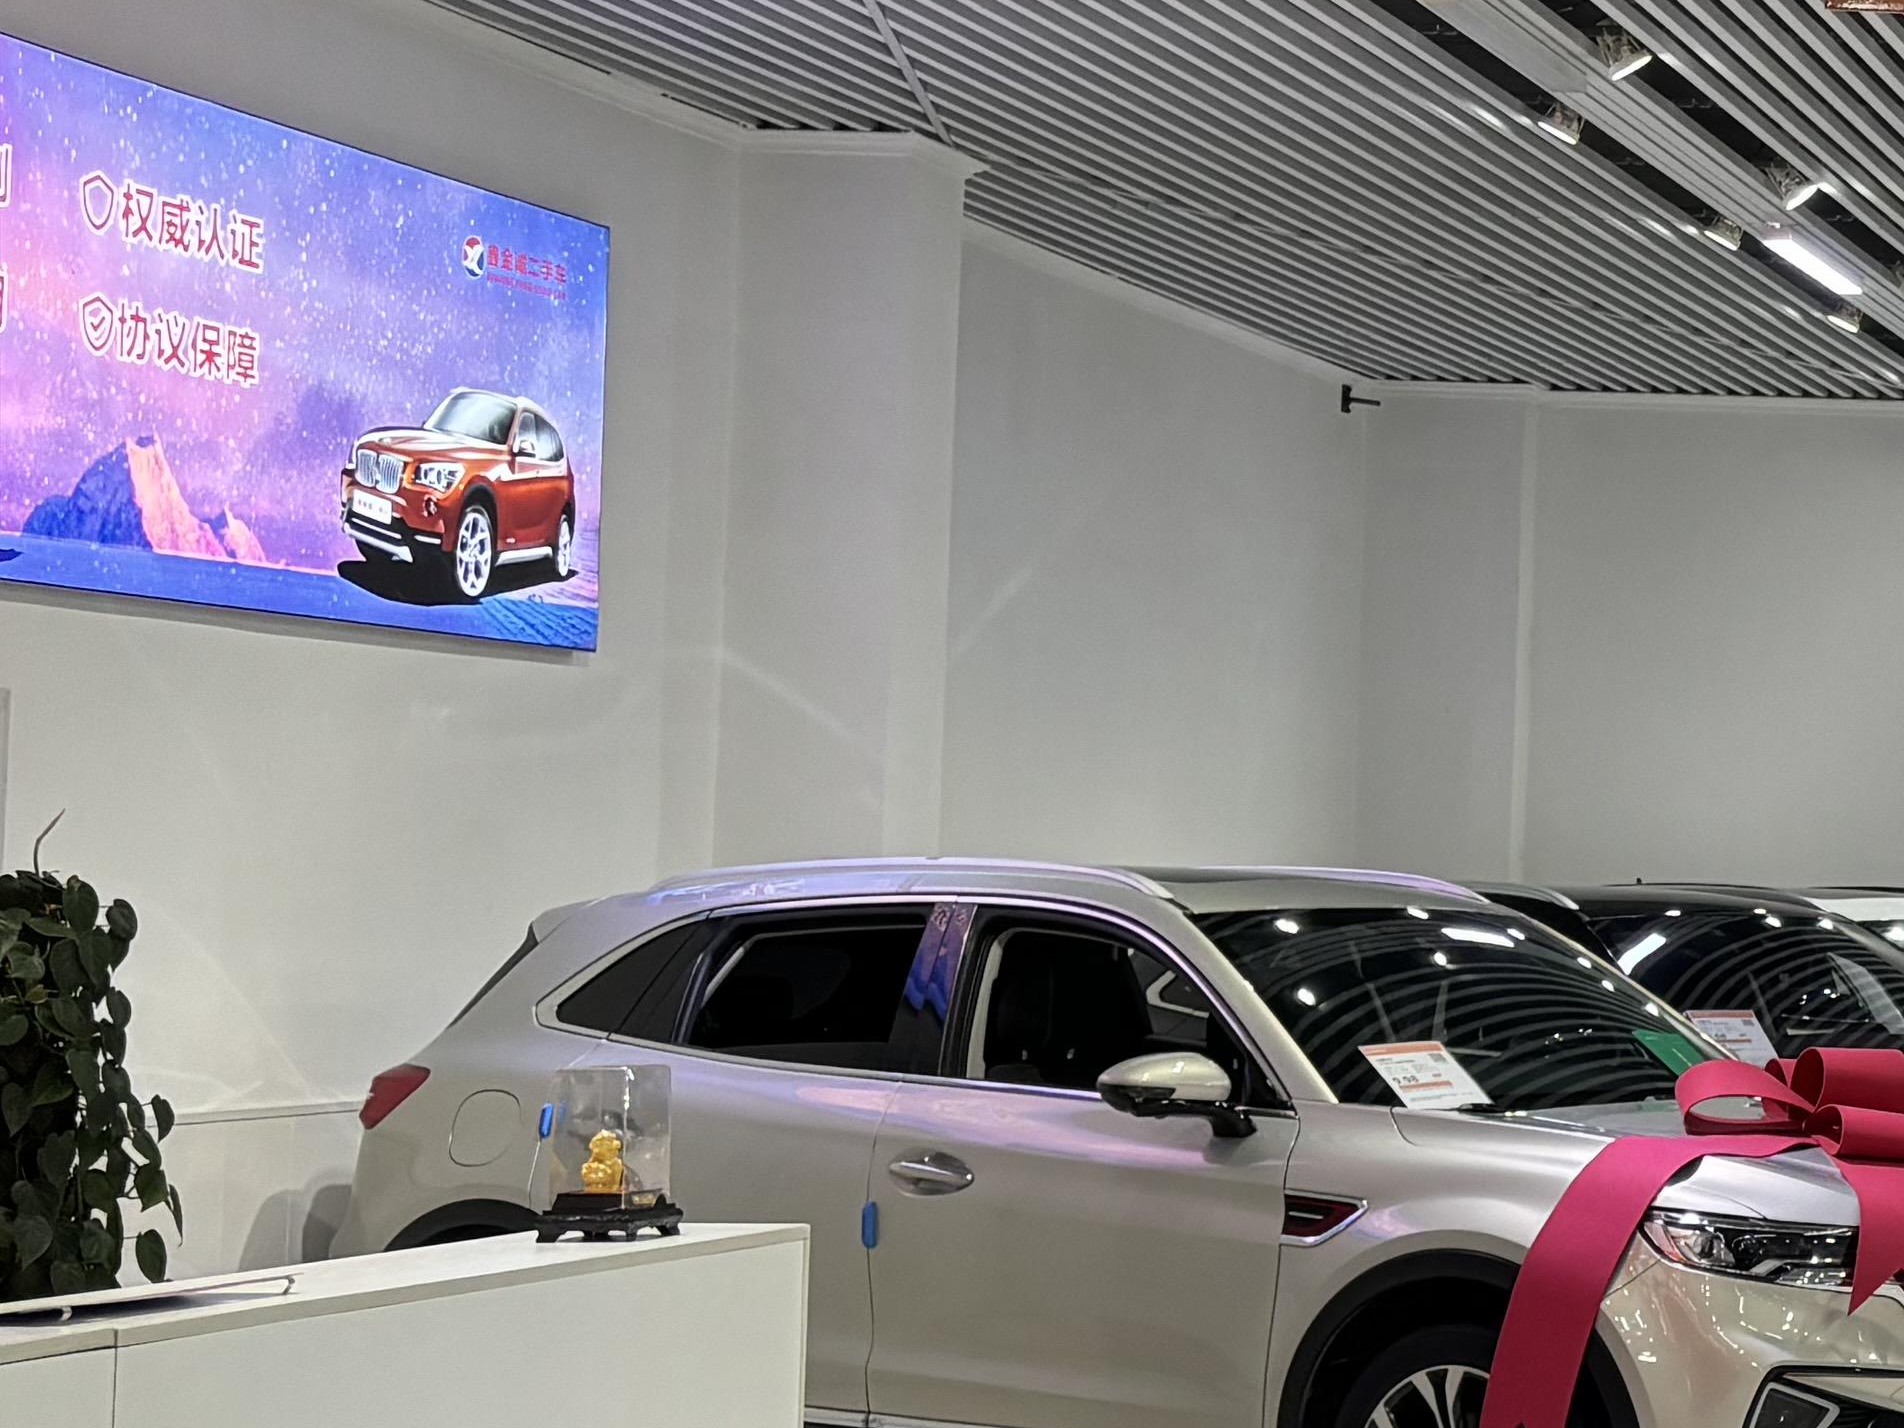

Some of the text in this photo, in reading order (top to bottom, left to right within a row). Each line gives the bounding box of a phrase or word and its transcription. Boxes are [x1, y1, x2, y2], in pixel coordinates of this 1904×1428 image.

[121, 182, 262, 270] 权威认证
[118, 302, 258, 382] 协议保障
